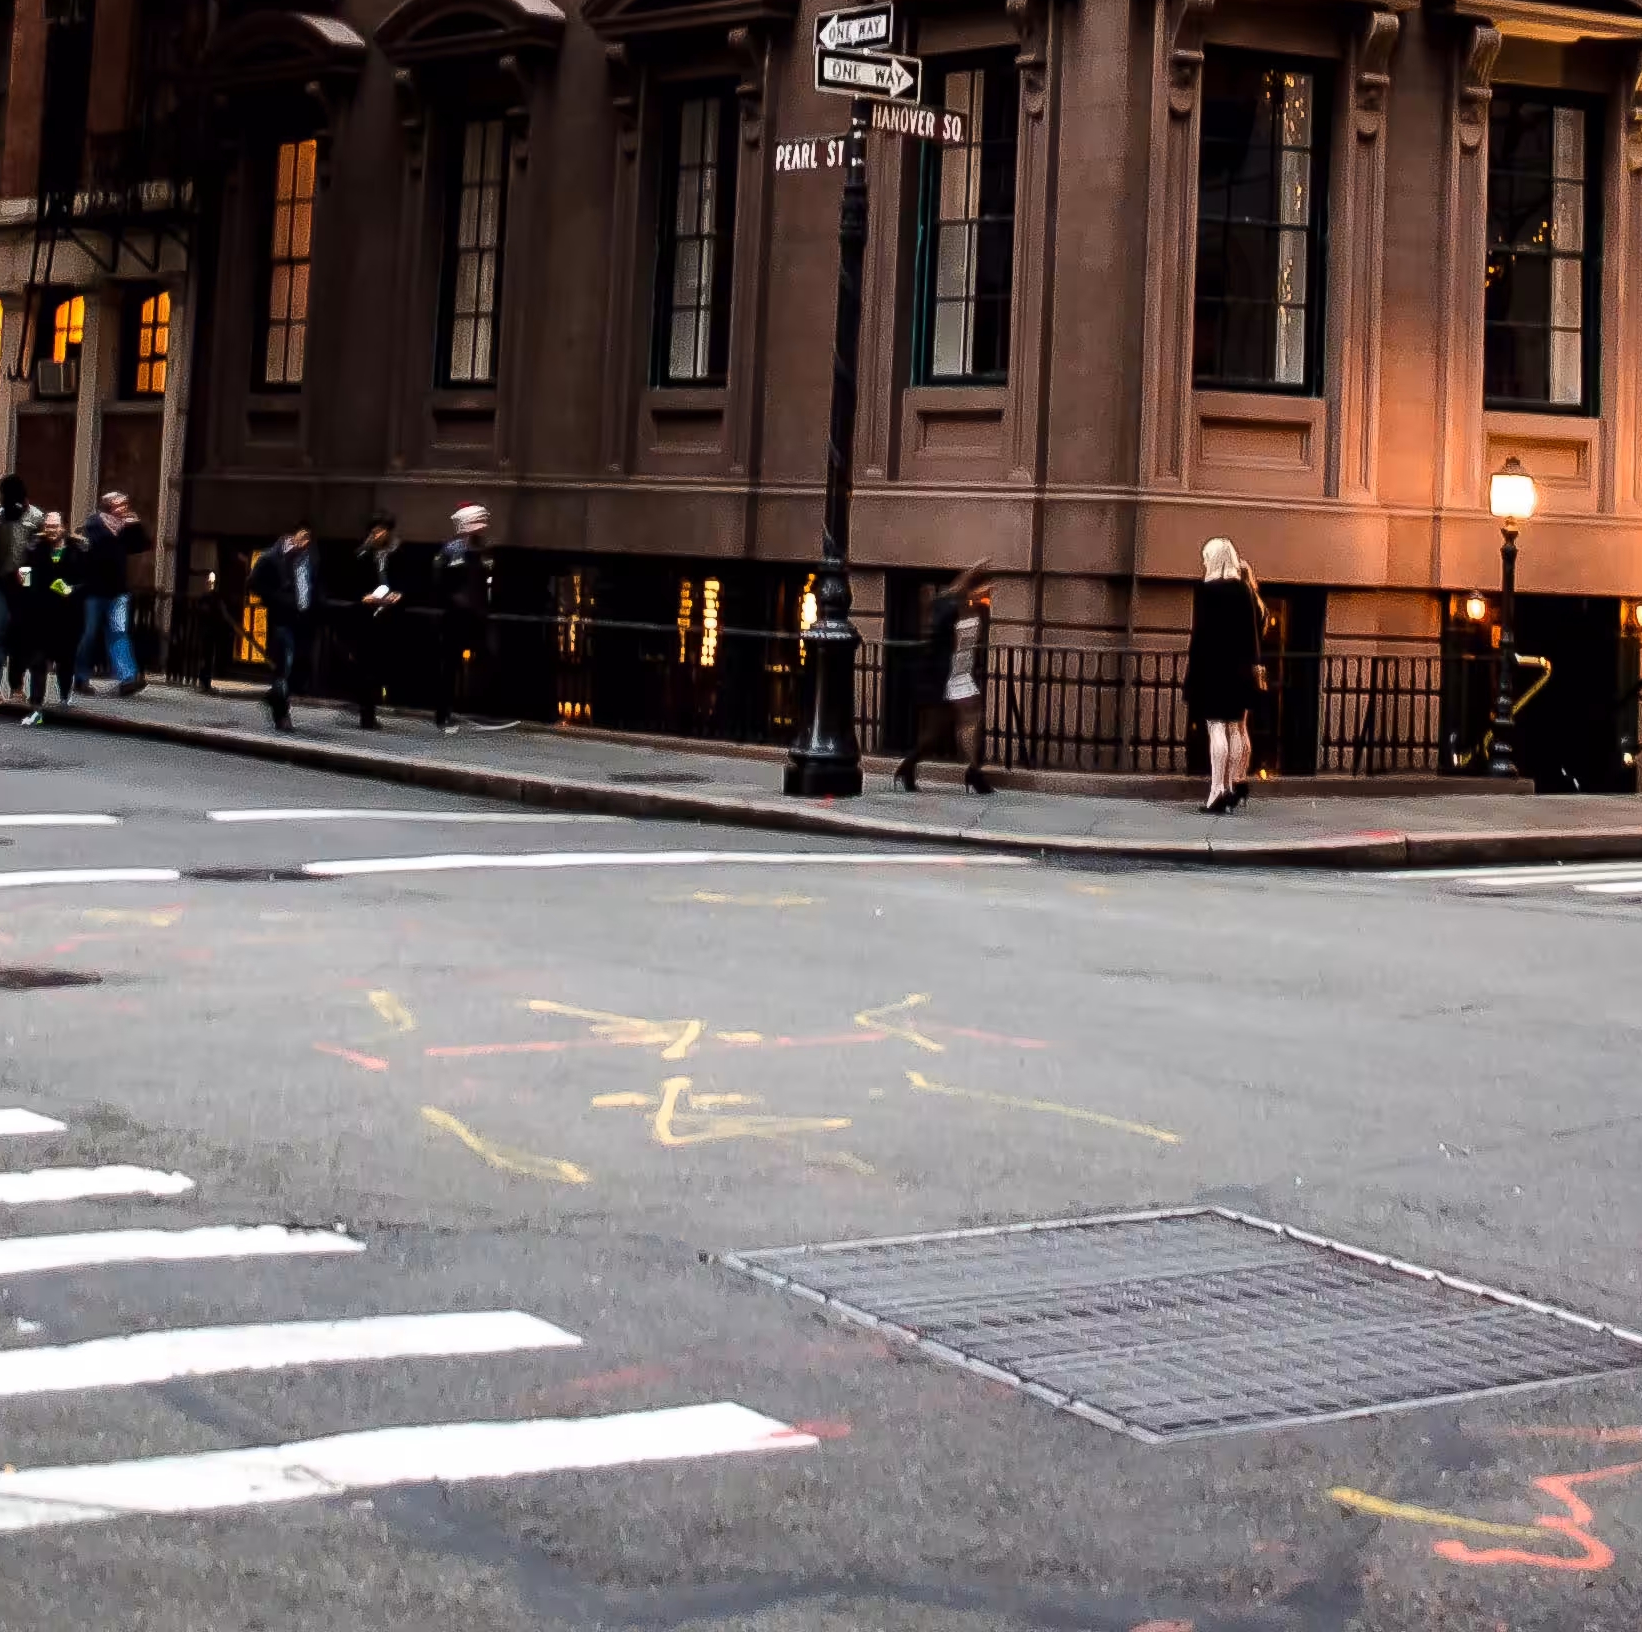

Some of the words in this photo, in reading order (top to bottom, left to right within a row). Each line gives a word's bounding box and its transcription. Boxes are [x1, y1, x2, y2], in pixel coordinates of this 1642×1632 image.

[828, 22, 851, 43] ONE
[859, 19, 883, 39] WAY
[832, 62, 861, 81] ONE
[875, 67, 905, 88] WAY
[872, 104, 935, 137] HANOVER
[775, 140, 818, 171] PEARL
[827, 140, 845, 167] ST
